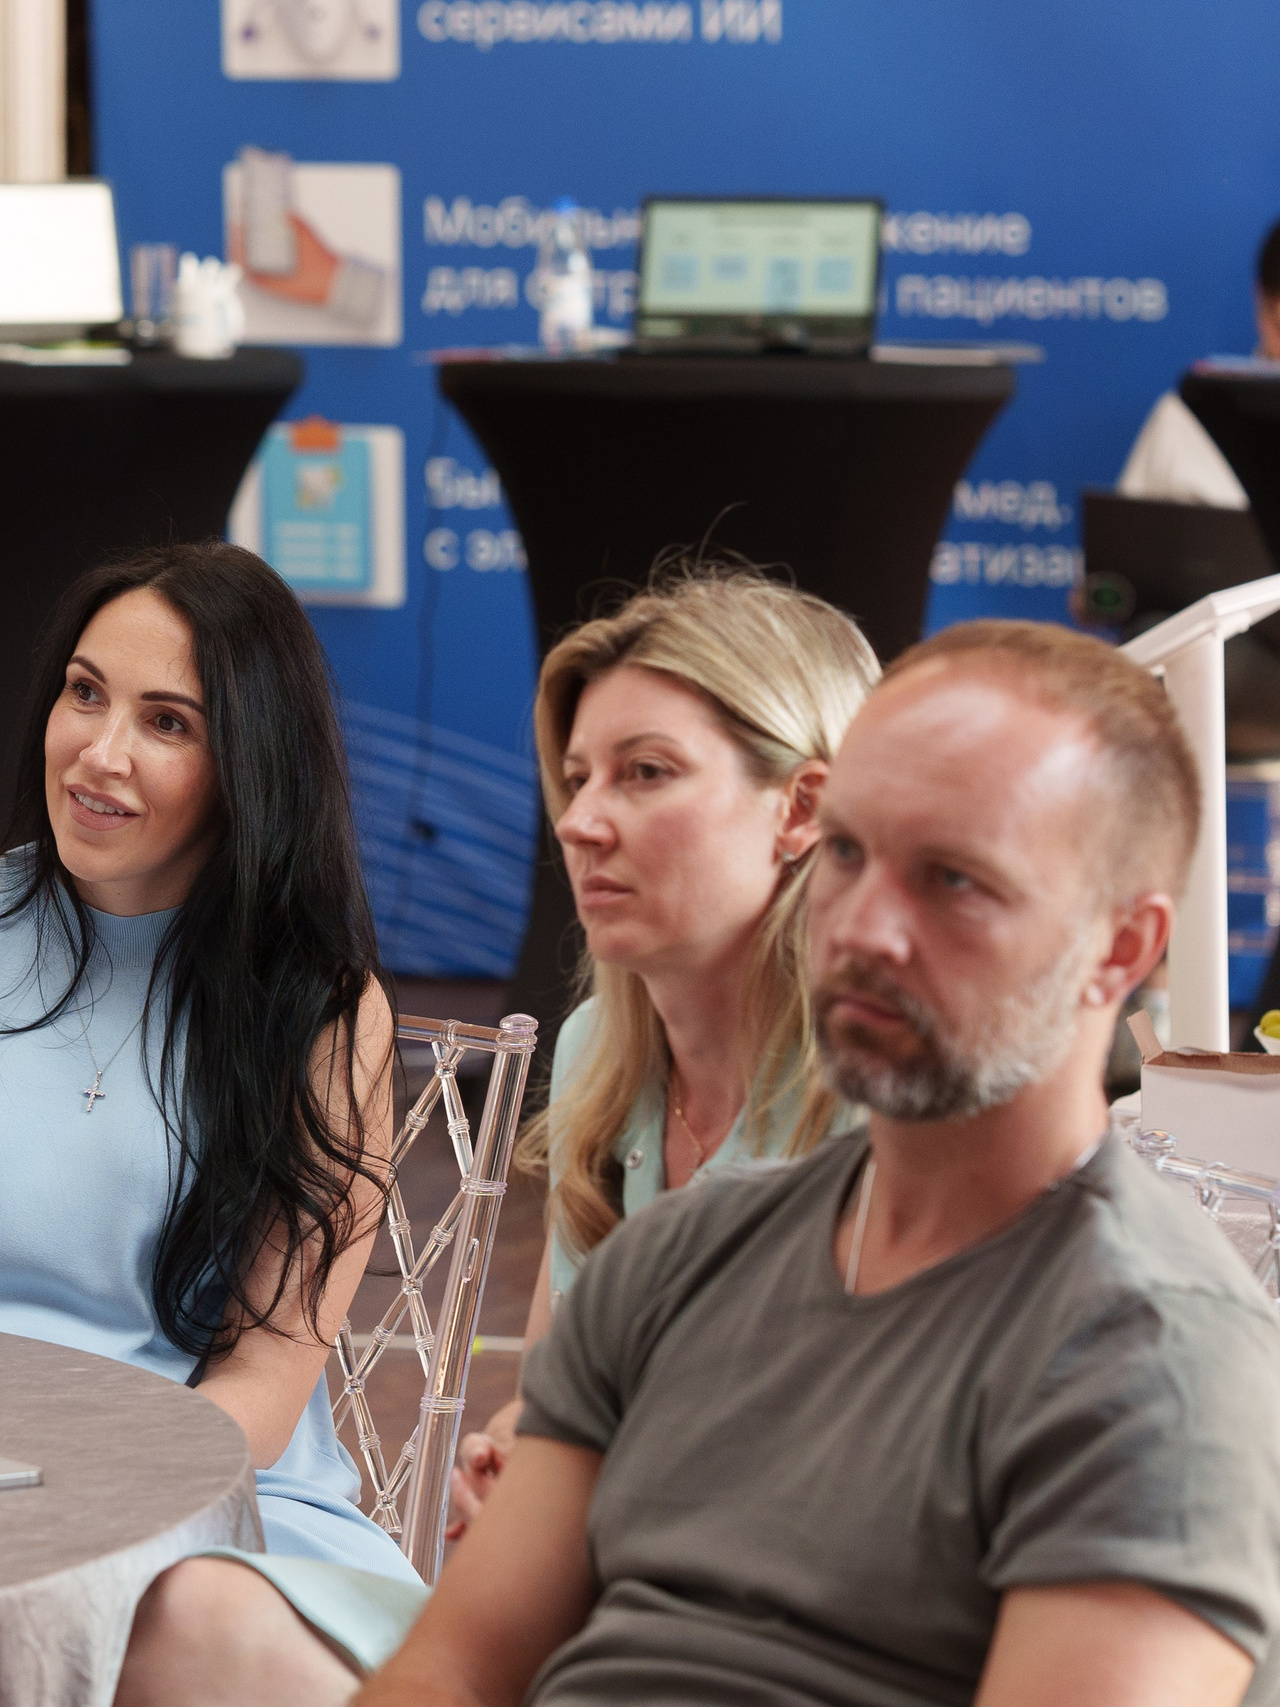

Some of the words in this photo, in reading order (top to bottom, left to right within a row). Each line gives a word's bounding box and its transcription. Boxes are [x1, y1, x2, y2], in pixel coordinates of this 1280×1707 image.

[418, 1, 693, 52] сервисами
[701, 0, 783, 45] ИИ
[424, 195, 642, 249] Мобильн
[423, 267, 518, 317] для
[895, 272, 1167, 328] пациентов
[424, 456, 502, 509] Бы
[424, 527, 460, 572] с
[465, 528, 529, 573] эл
[928, 541, 1086, 589] атиза
